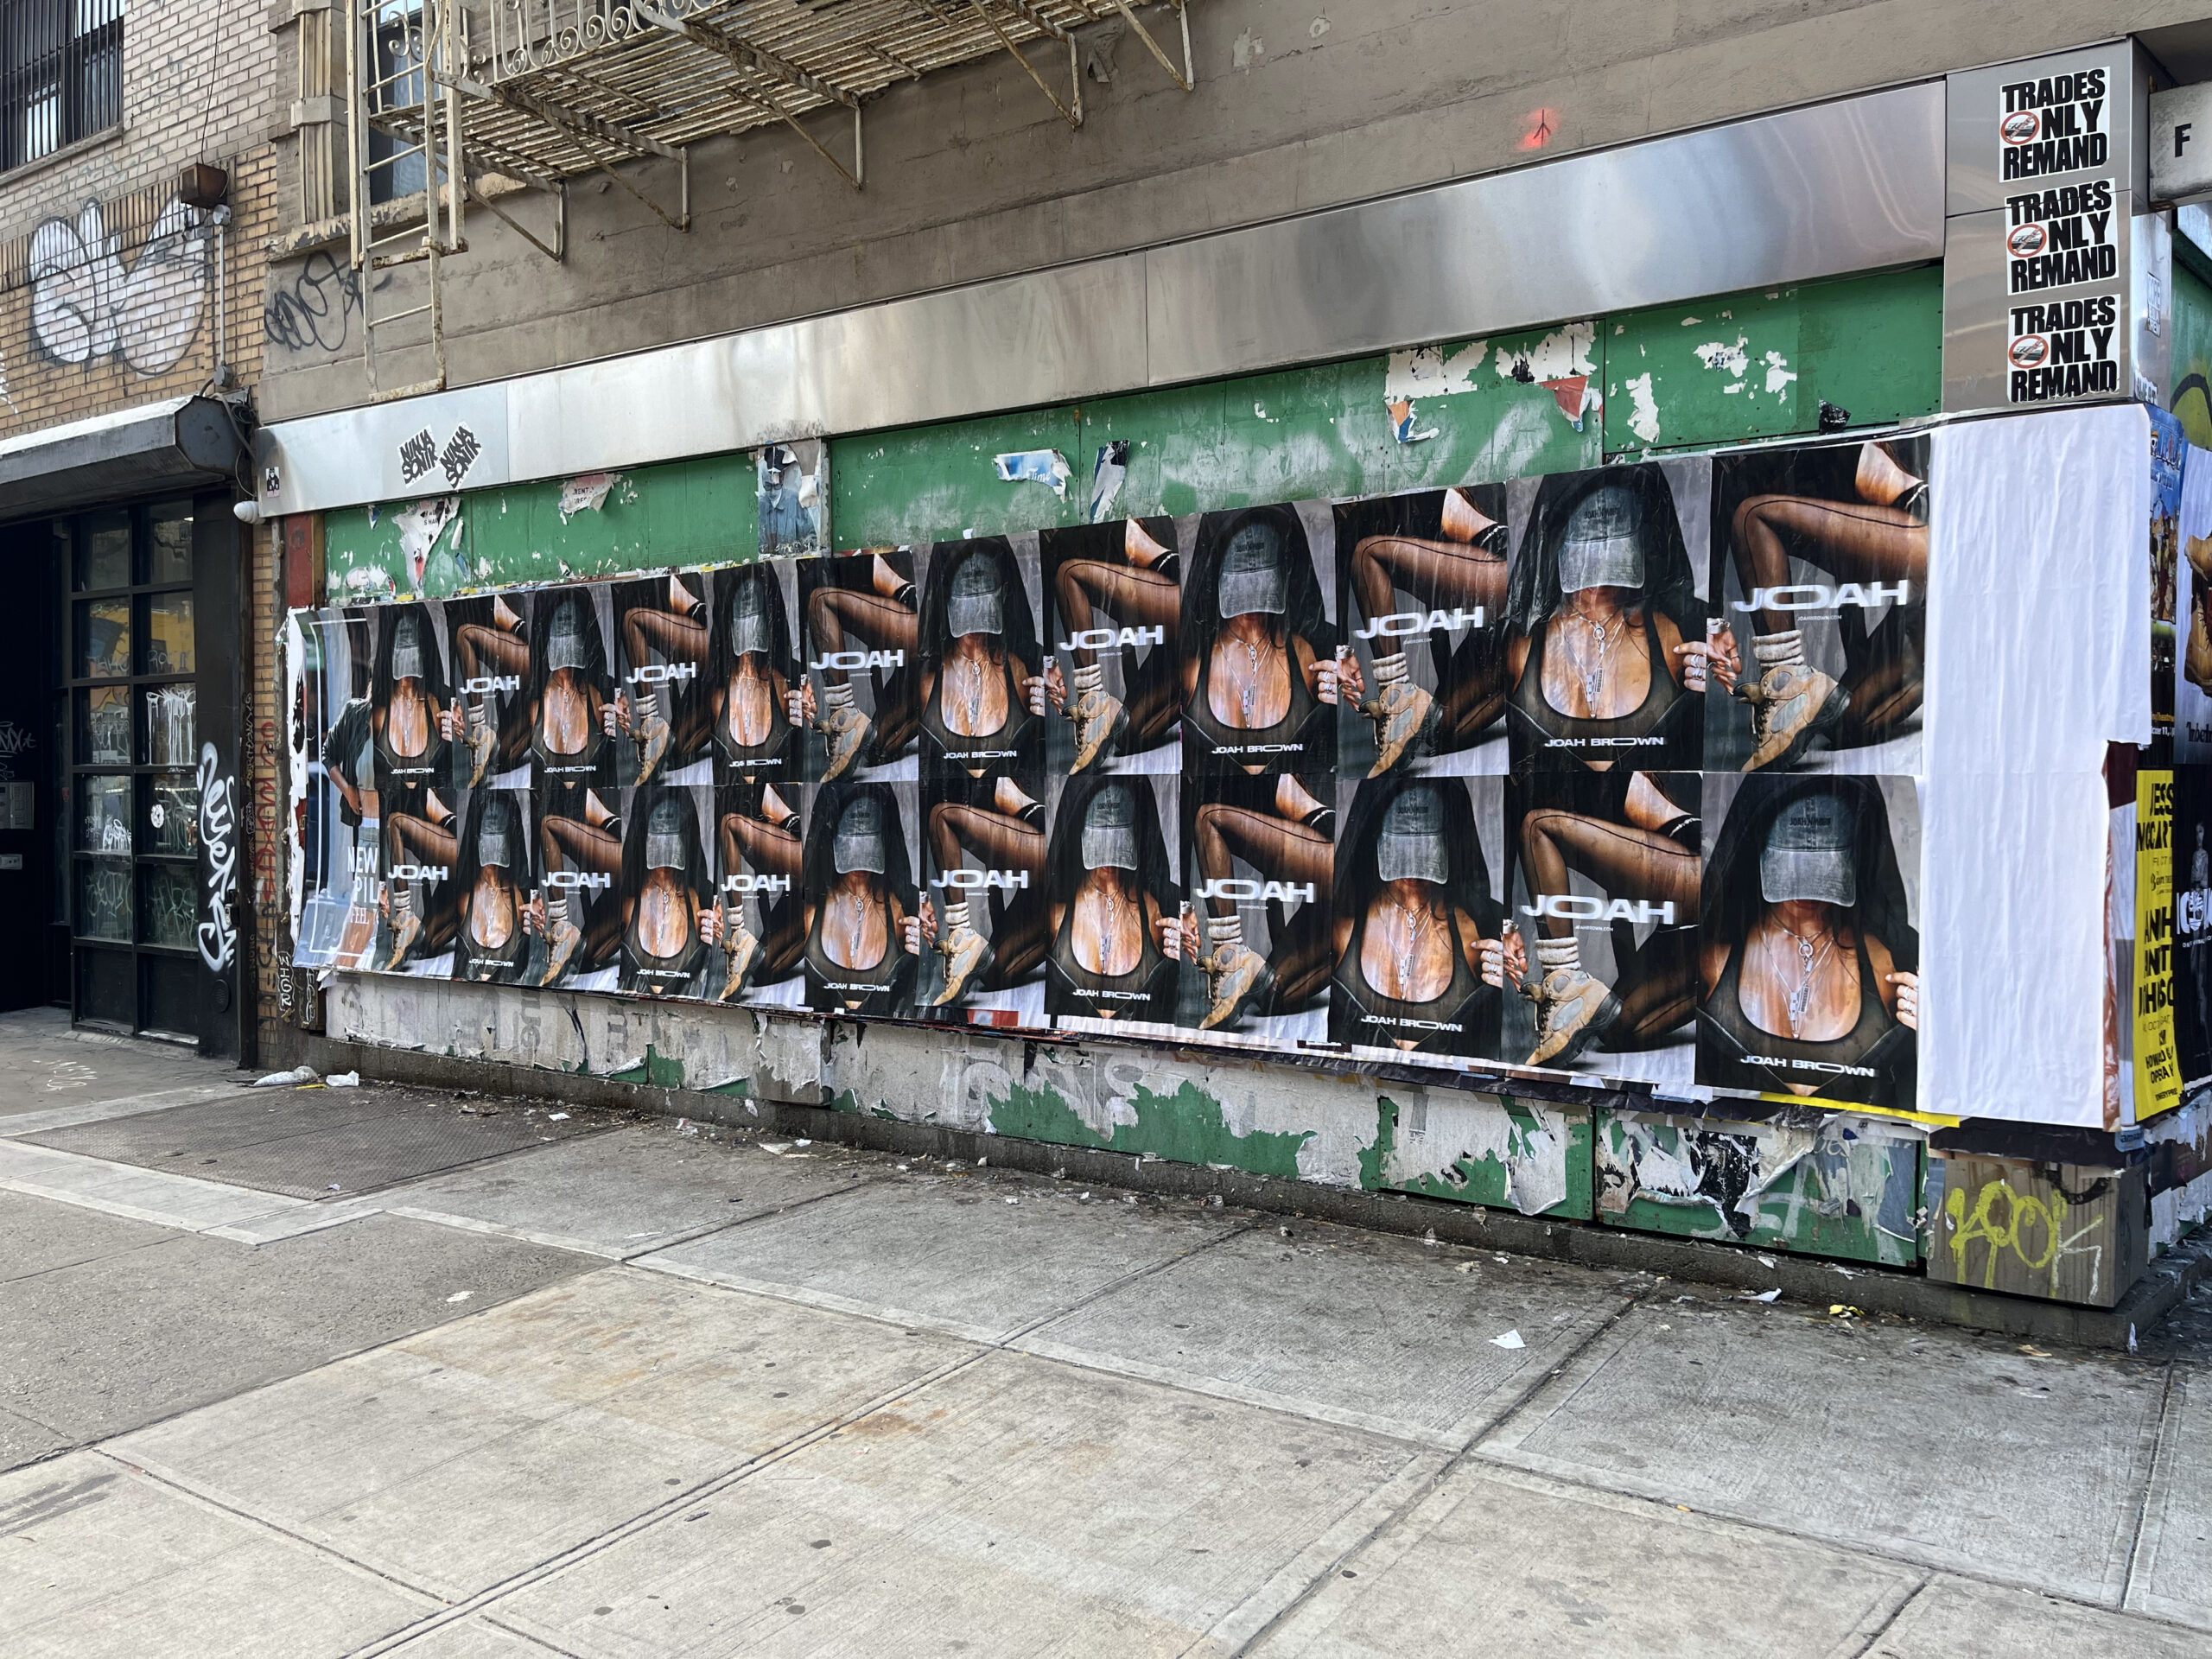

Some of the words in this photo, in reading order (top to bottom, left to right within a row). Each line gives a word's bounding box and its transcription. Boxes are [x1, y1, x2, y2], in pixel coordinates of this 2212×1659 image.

[2002, 68, 2106, 113] TRADES
[2003, 132, 2107, 181] REMAND
[2006, 181, 2112, 226] TRADES
[2011, 244, 2116, 293] REMAND
[2011, 296, 2116, 336] TRADES
[2012, 360, 2117, 403] REMAND
[1732, 580, 1909, 612] JOAH
[1355, 606, 1484, 639] JOAH
[1059, 625, 1163, 651] JOAH
[810, 648, 904, 671] JOAH
[626, 662, 696, 683] JOAH
[460, 675, 520, 694] JOAH
[1211, 746, 1243, 754] JOAH
[1247, 743, 1303, 753] BROWN
[1544, 738, 1586, 747] JOAH
[1590, 736, 1664, 747] BROWN
[971, 750, 1017, 759] BROWN
[347, 846, 378, 874] NEW
[388, 865, 448, 880] JOAH
[541, 871, 611, 888] JOAH
[721, 874, 791, 892] JOAH
[931, 870, 1028, 889] JOAH
[1195, 879, 1314, 903] JOAH
[1522, 894, 1675, 925] JOAH
[485, 959, 514, 968] BROWN
[849, 983, 890, 992] BROWN
[1073, 988, 1099, 997] JOAH
[1102, 990, 1150, 1001] BROWN
[1361, 1014, 1396, 1026] JOAH
[1399, 1018, 1463, 1033] BROWN
[1740, 1055, 1787, 1068] JOAH
[1791, 1059, 1874, 1077] BROWN
